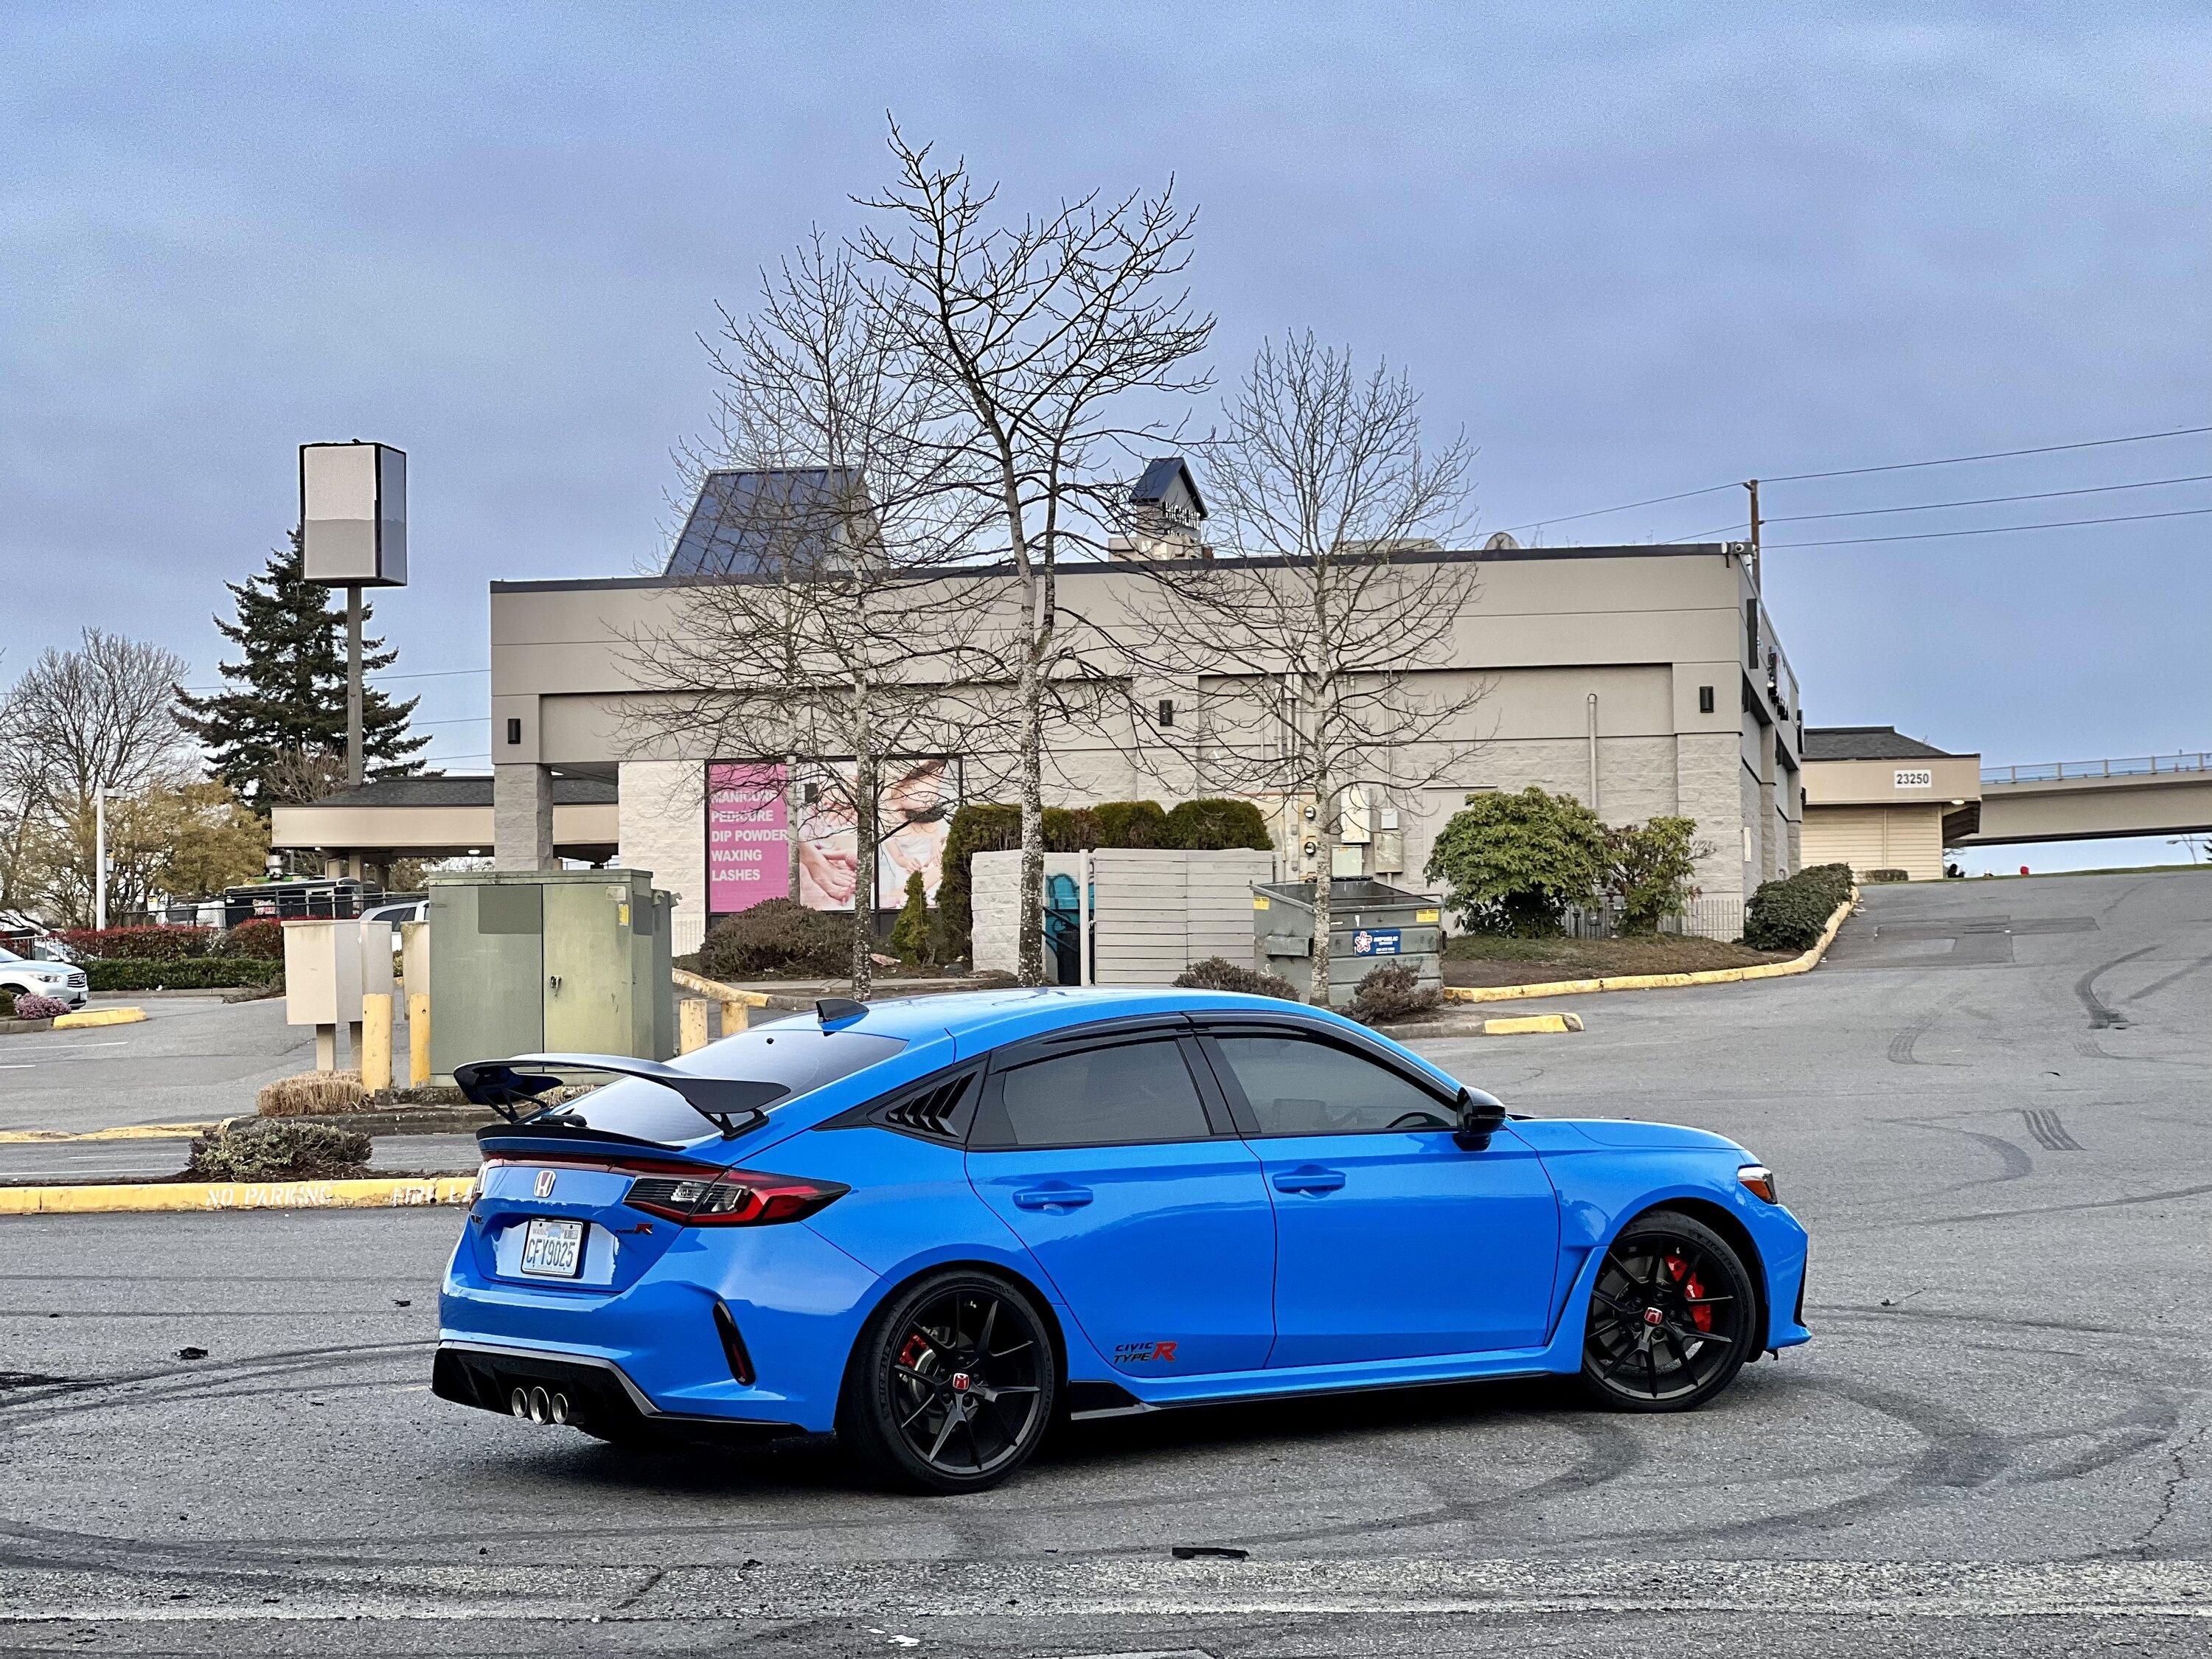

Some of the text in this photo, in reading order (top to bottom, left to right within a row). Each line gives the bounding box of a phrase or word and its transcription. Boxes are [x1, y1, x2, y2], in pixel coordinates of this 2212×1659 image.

[1165, 501, 1200, 530] HIGHLINE
[1896, 773, 1929, 784] 23250
[711, 810, 774, 823] PEDICURE
[712, 829, 788, 842] DIP POWDER
[712, 849, 762, 862] WAXING
[712, 869, 761, 881] LASHES
[206, 1189, 234, 1206] NO
[526, 1238, 576, 1267] CFY9025
[1114, 1340, 1178, 1364] TYPE R
[1115, 1342, 1154, 1352] CIVIC
